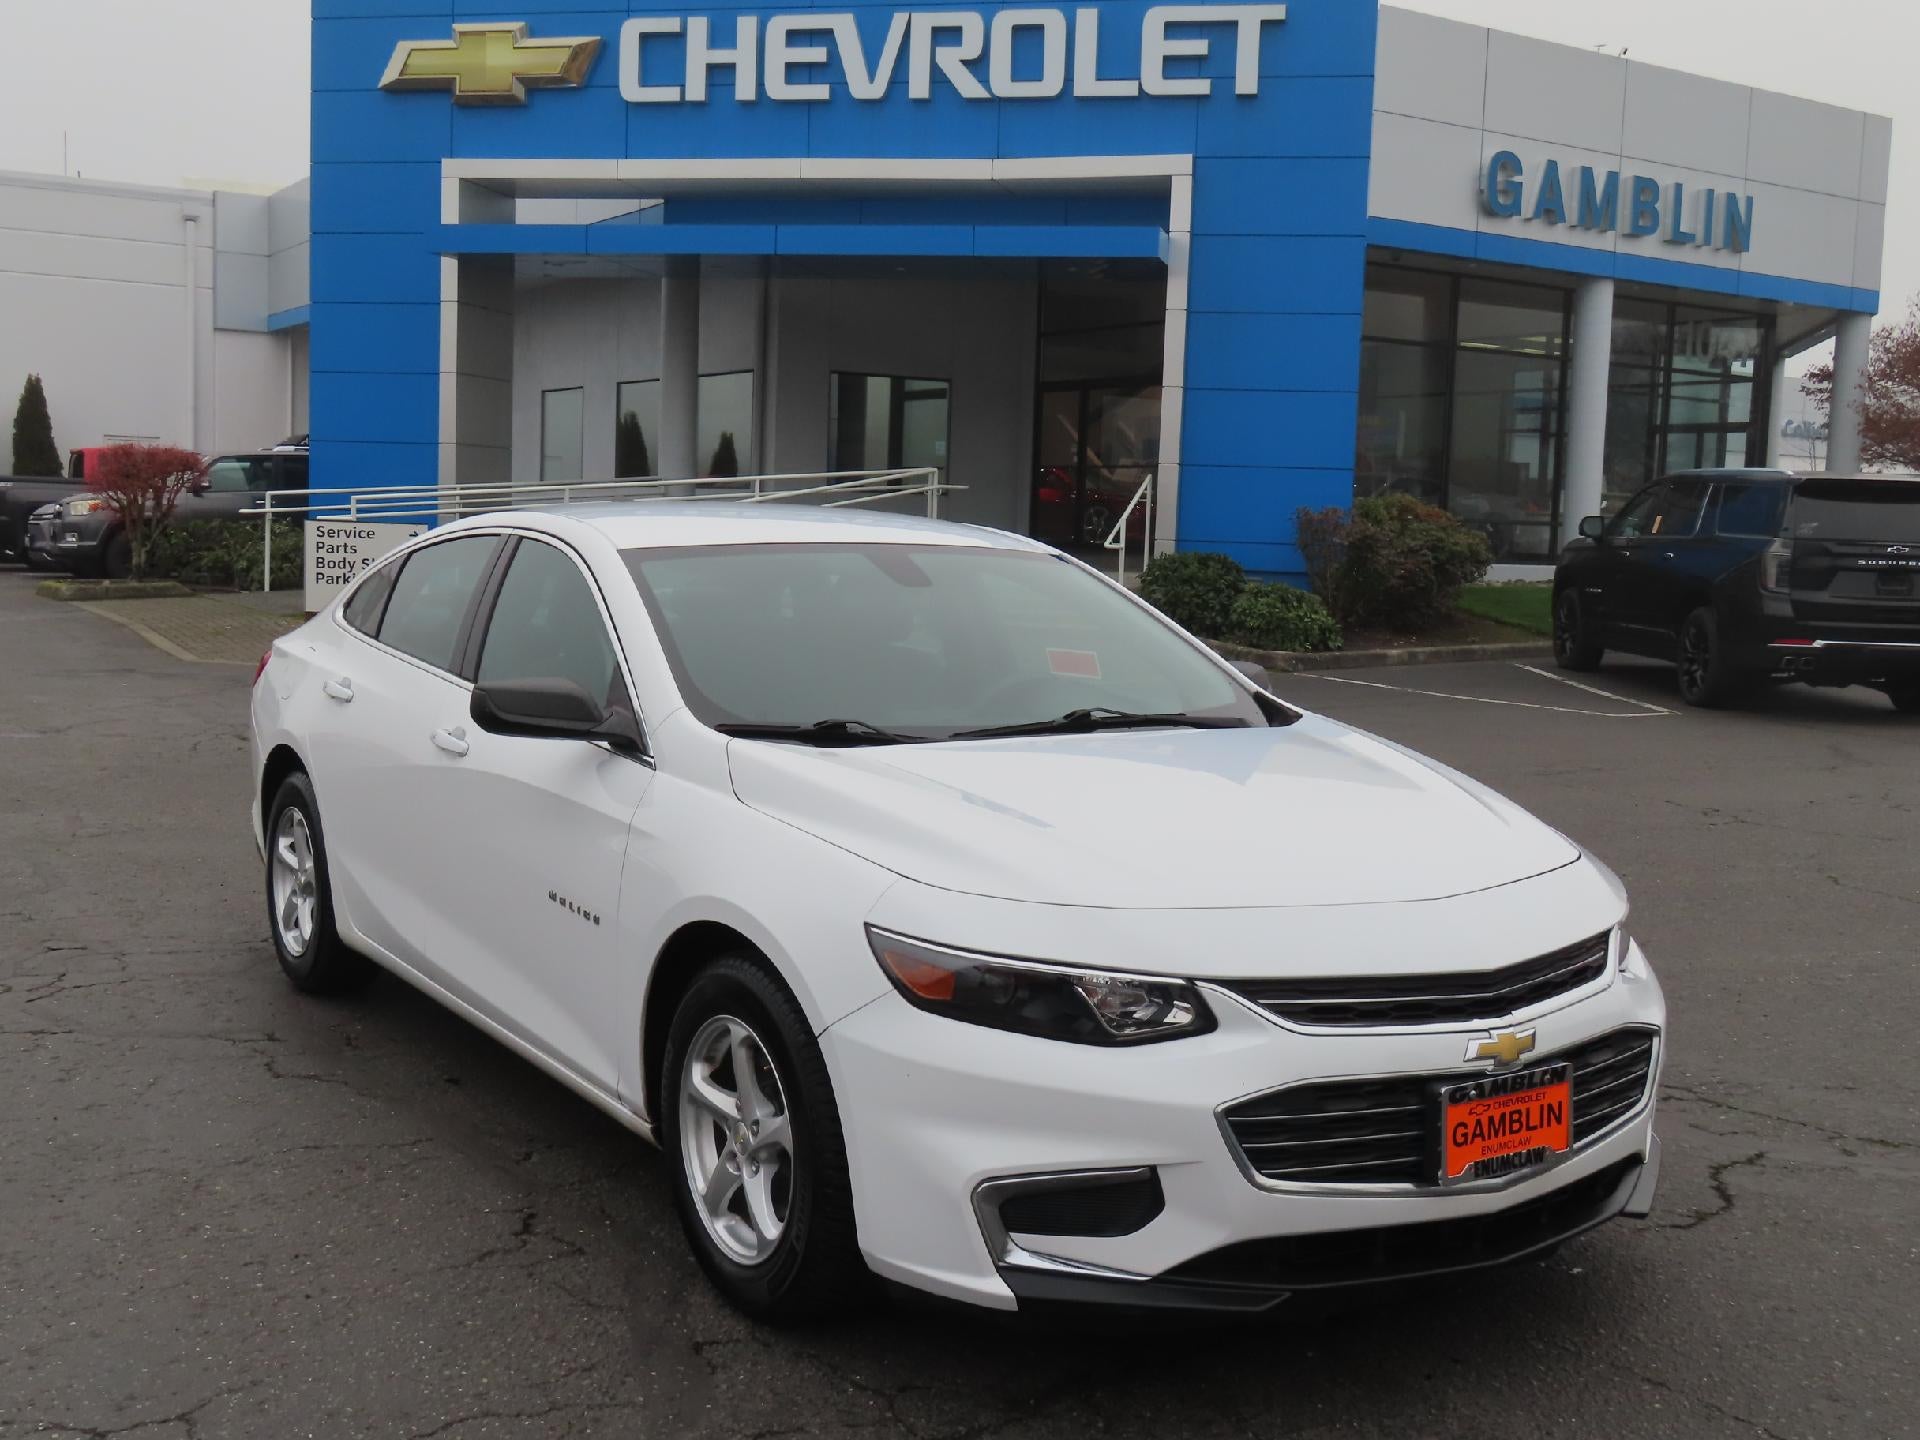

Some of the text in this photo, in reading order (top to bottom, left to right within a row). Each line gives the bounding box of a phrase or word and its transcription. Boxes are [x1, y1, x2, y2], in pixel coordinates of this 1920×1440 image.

[619, 4, 1287, 103] CHEVROLET
[1482, 149, 1754, 254] GAMBLIN
[316, 525, 376, 540] Service
[316, 541, 358, 554] Parts
[316, 556, 376, 573] Body S
[1493, 1092, 1547, 1111] CHEVROLET
[1452, 1100, 1563, 1148] GAMBLIN
[1481, 1135, 1532, 1156] ENUMCLAW
[1474, 1146, 1545, 1179] ENUMCLAW
